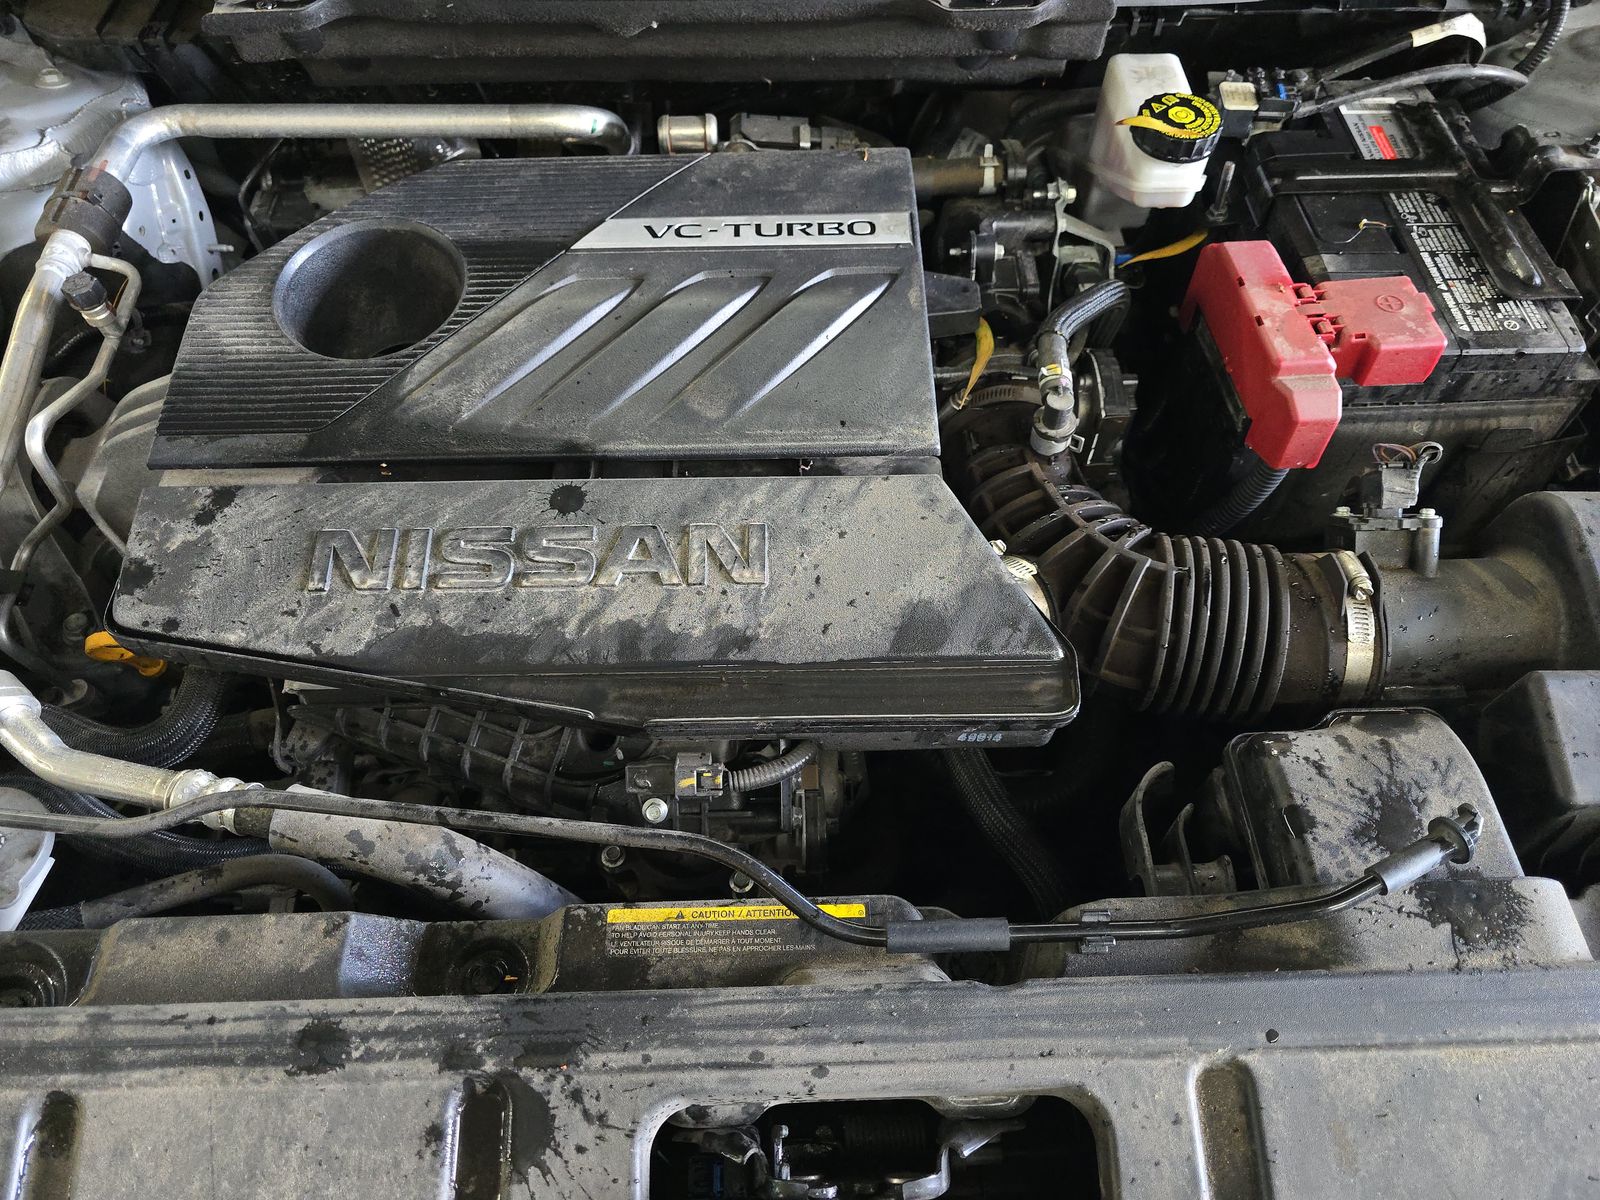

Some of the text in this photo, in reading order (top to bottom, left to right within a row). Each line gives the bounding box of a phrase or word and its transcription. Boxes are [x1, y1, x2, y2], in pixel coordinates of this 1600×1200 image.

[643, 220, 877, 239] VC-TURBO
[305, 523, 769, 592] NISSAN
[691, 910, 735, 918] CAUTION
